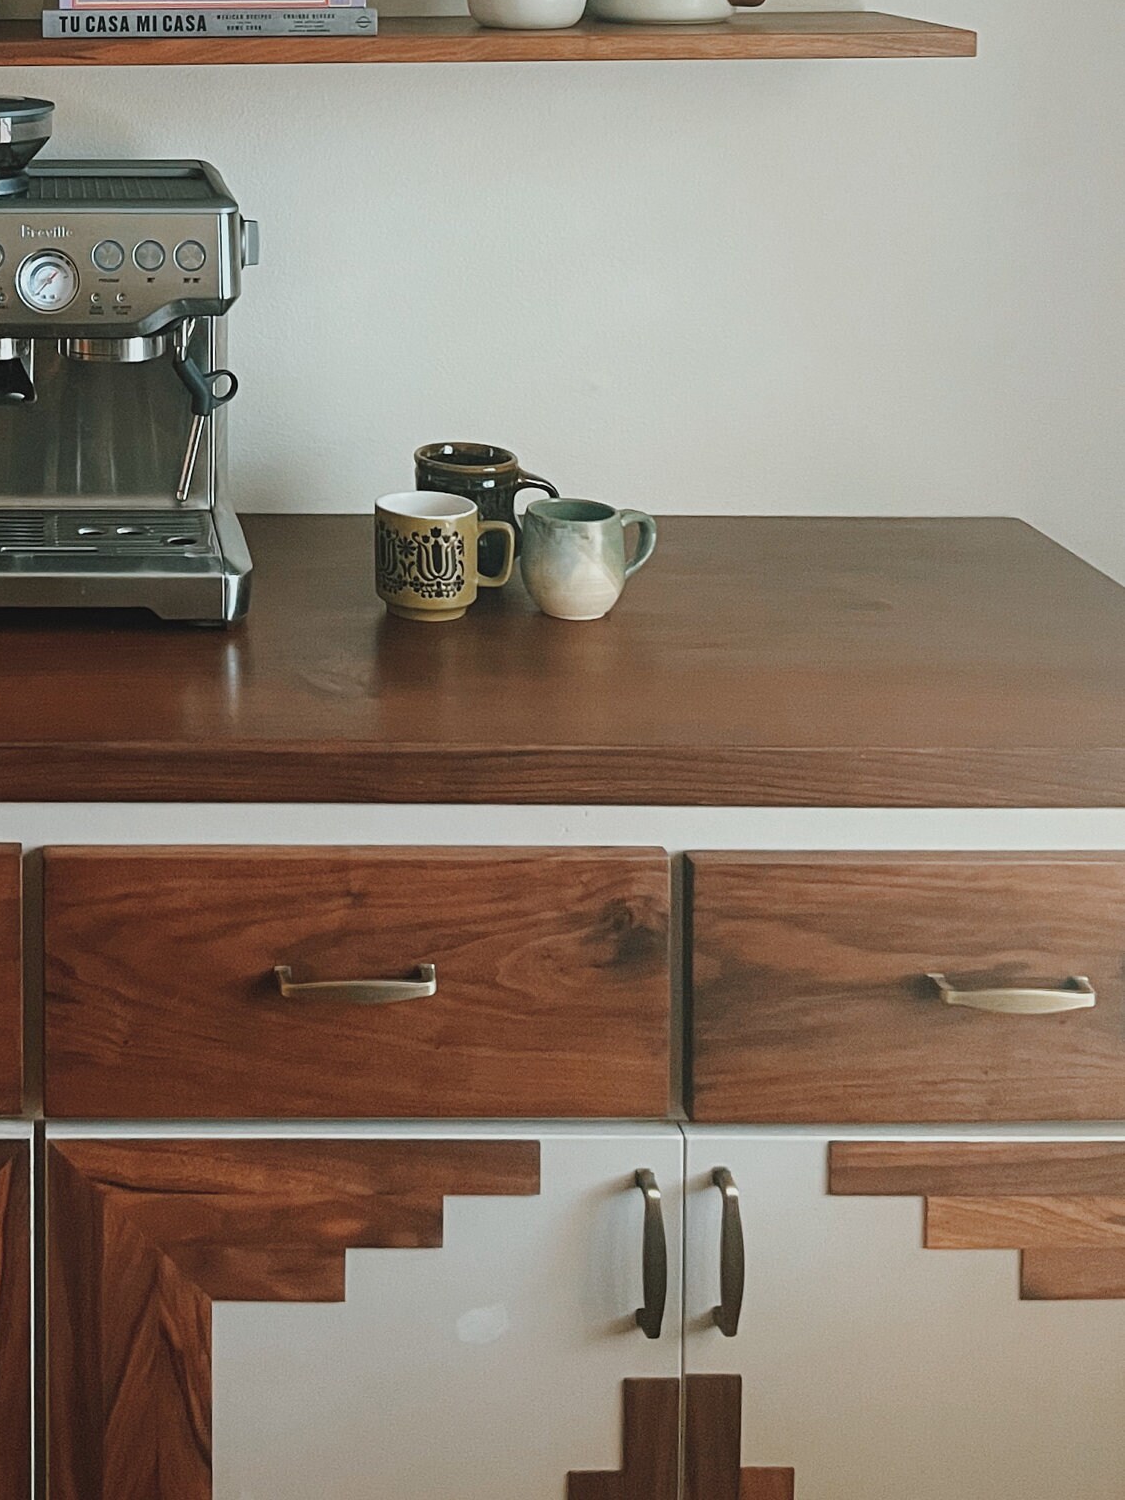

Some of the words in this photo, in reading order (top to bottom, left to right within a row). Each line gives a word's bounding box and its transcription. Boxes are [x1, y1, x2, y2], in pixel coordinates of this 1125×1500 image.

[59, 16, 80, 33] TU
[85, 15, 130, 33] CASA
[136, 15, 157, 32] MI
[162, 14, 207, 33] CASA
[21, 224, 74, 238] Breville
